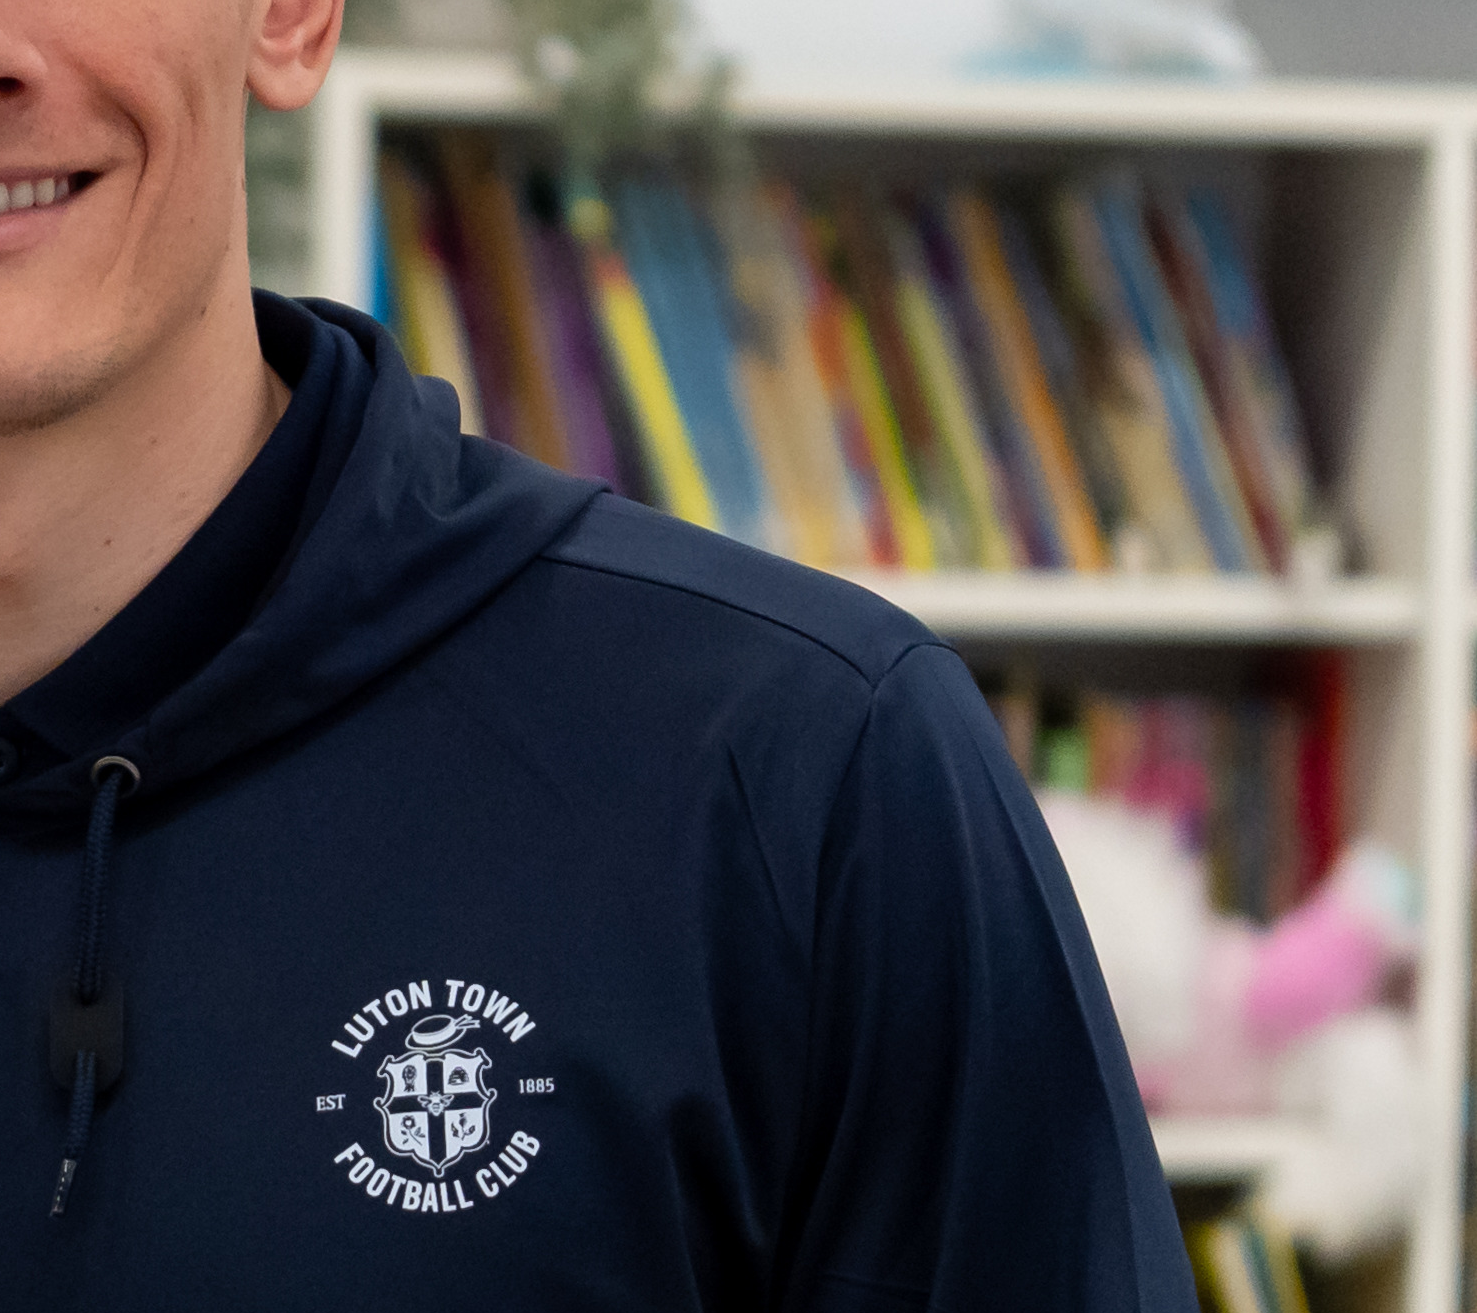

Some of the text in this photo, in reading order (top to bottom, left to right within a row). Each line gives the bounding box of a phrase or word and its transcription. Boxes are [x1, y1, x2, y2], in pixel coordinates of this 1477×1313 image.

[331, 979, 536, 1058] LUTON TOWN
[316, 1078, 555, 1111] EST 1885
[334, 1130, 540, 1213] FOOTBALL CLUB
